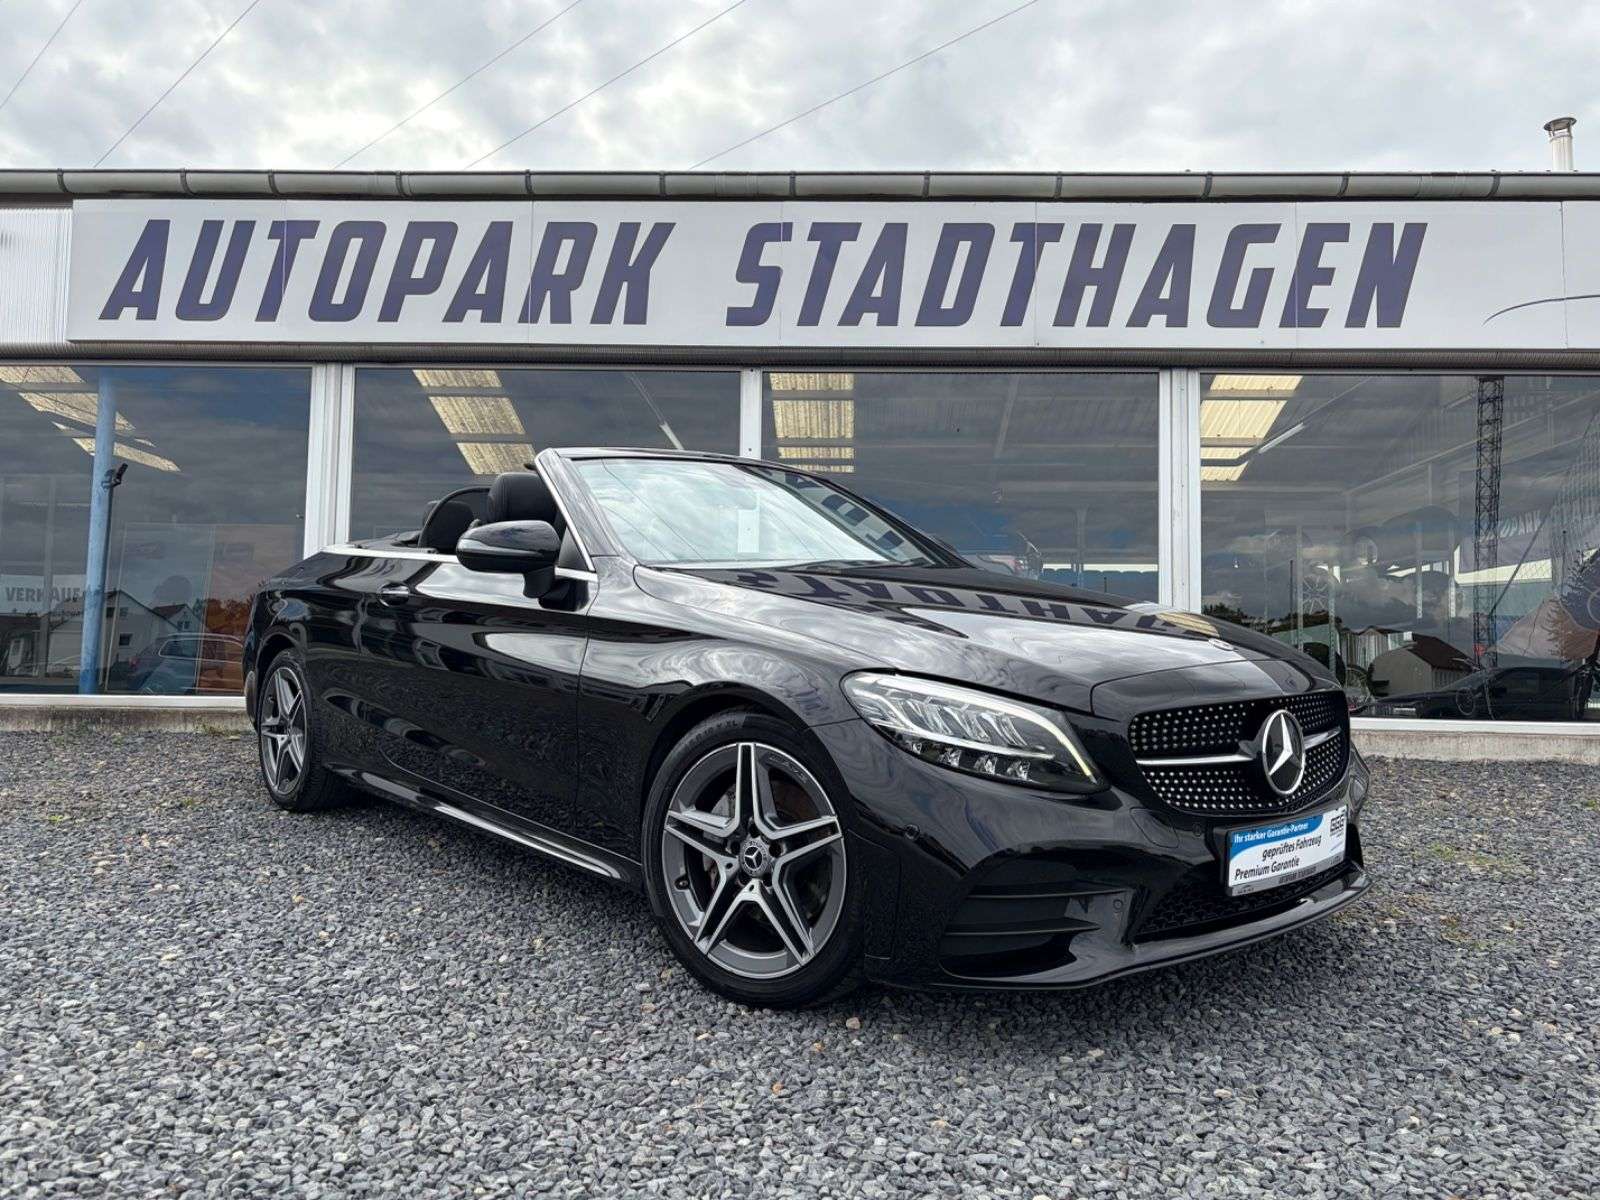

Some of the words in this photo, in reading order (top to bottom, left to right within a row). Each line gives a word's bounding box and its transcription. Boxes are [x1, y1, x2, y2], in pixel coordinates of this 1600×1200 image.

[98, 219, 676, 325] AUTOPARK
[726, 222, 1428, 328] STADTHAGEN
[1234, 832, 1244, 844] Ihr
[1244, 830, 1267, 842] starker
[1262, 842, 1295, 862] geprüftes
[1295, 834, 1322, 852] Fahrzeug
[1234, 864, 1270, 881] Premium
[1270, 856, 1300, 873] Garantie
